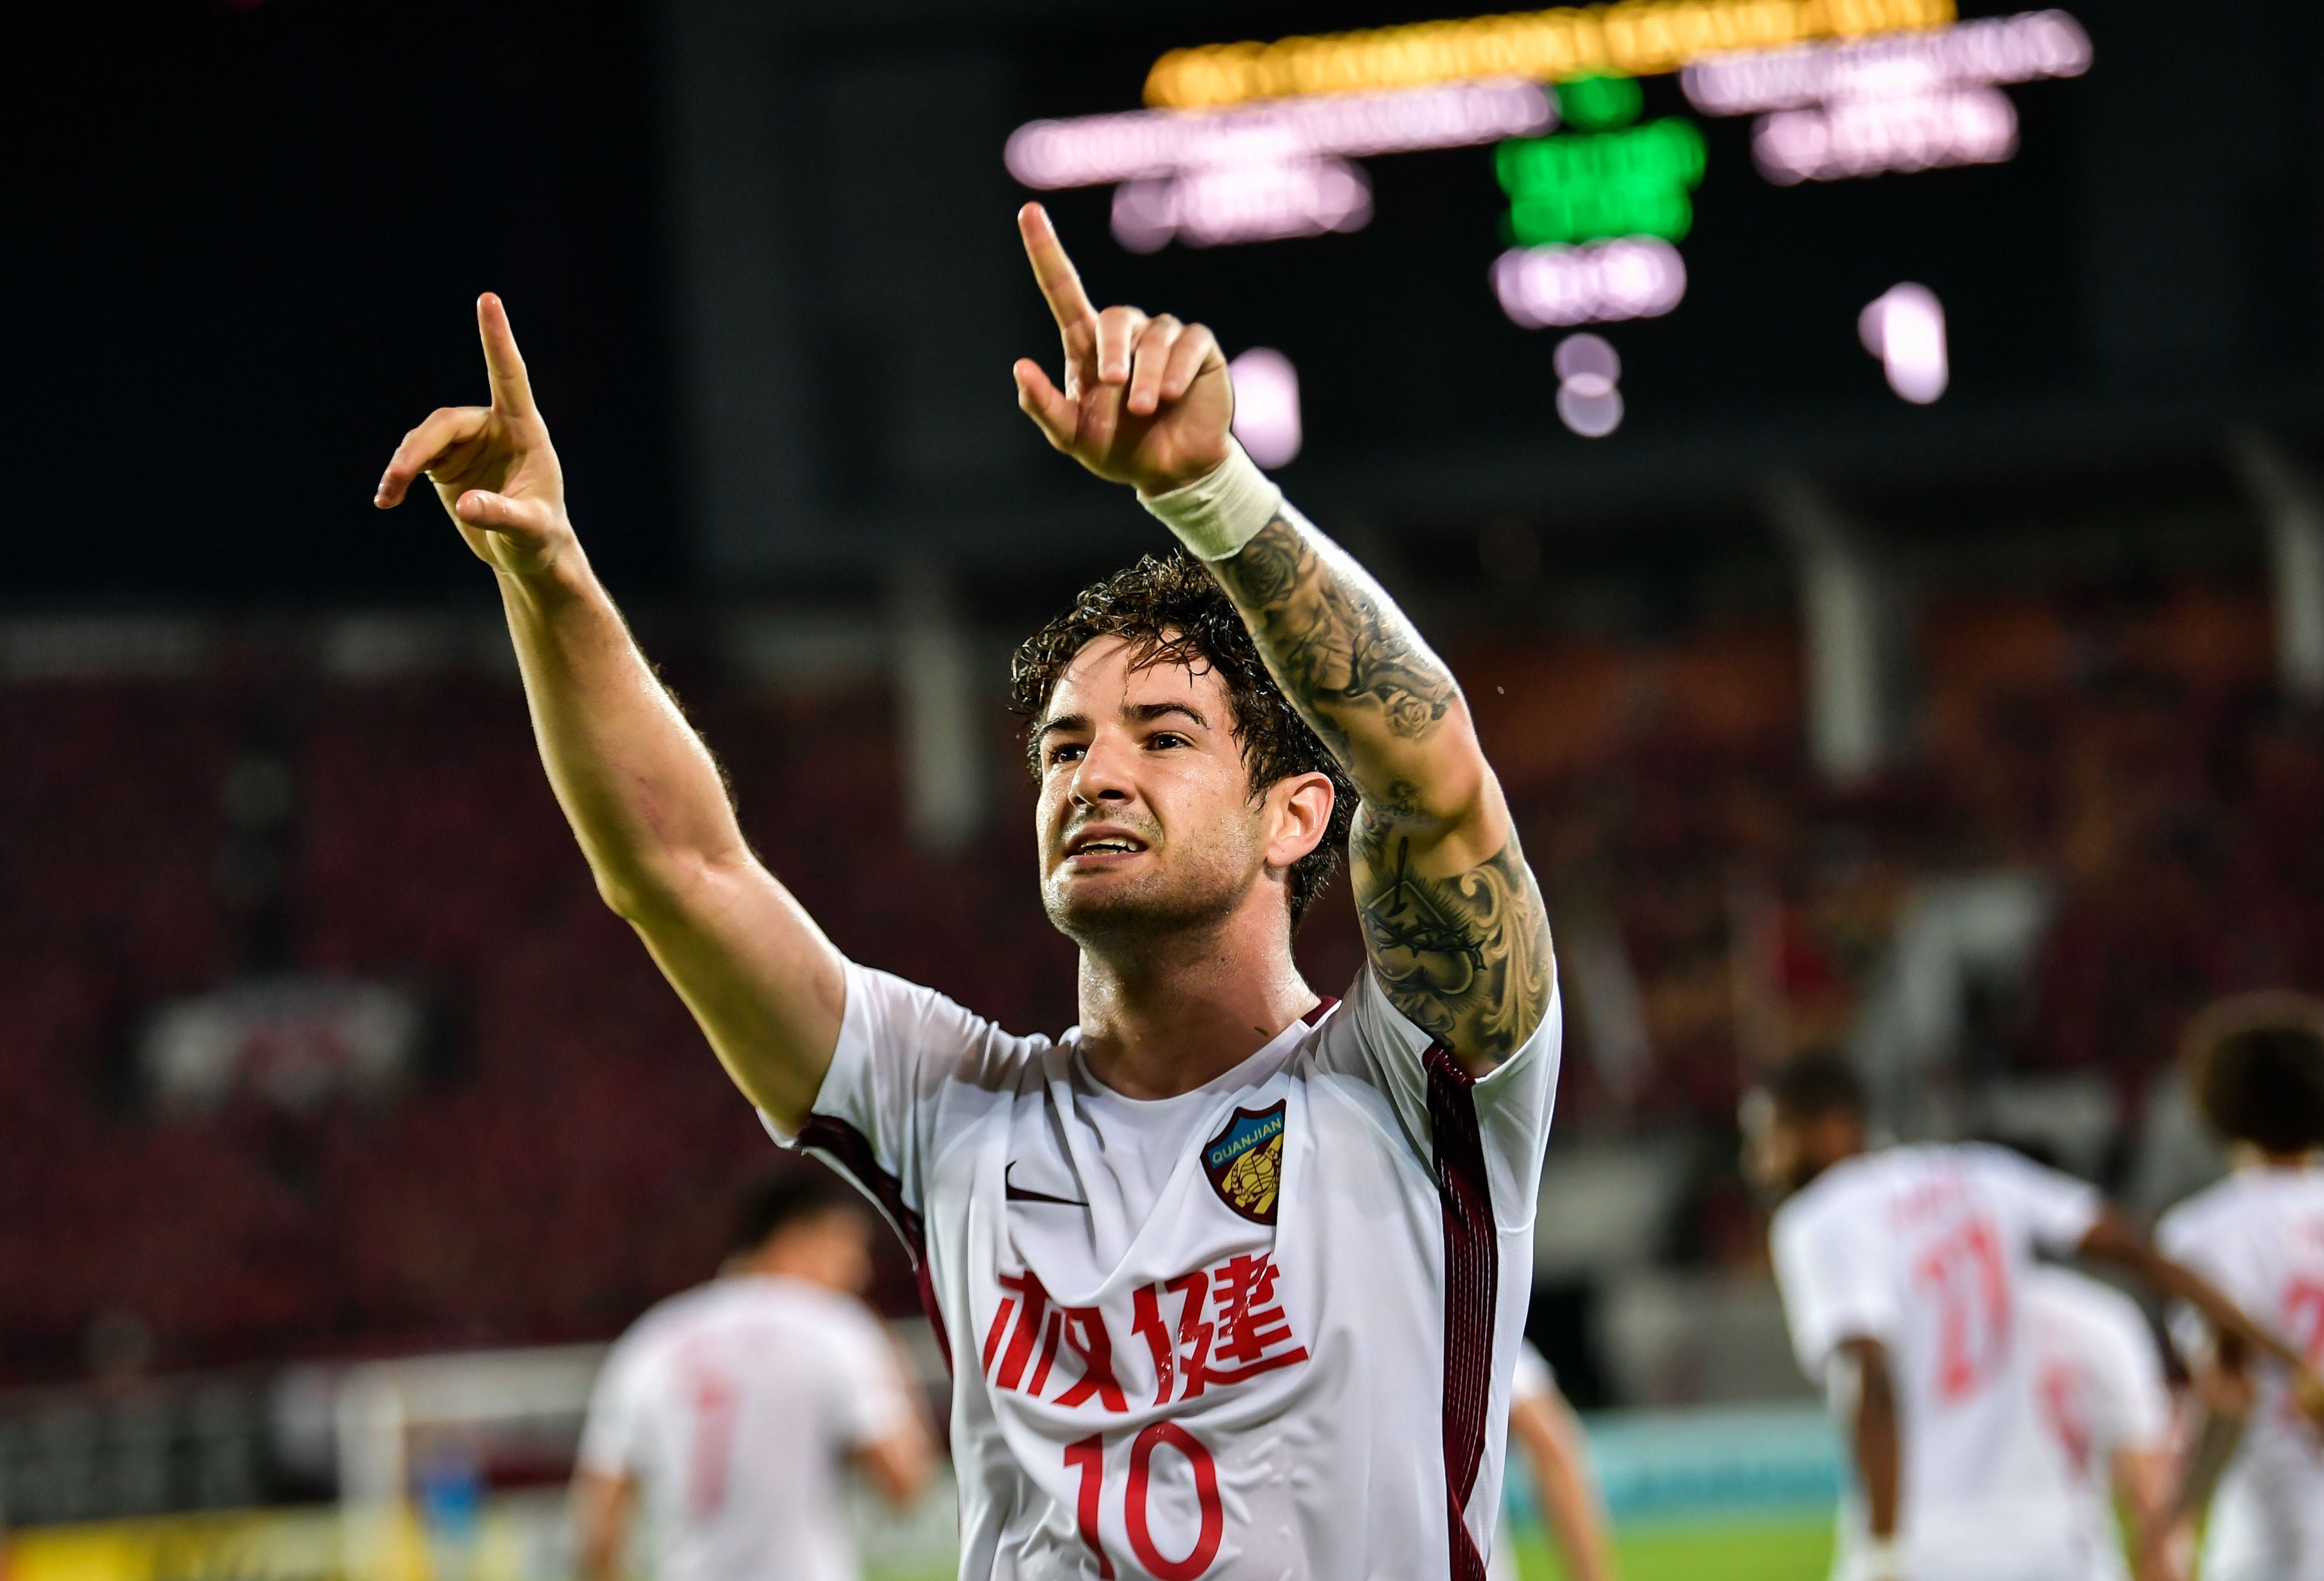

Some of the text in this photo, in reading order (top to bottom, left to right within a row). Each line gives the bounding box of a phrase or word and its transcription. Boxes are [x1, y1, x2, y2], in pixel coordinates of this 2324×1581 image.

[1212, 1117, 1282, 1164] QUANJIAN
[982, 1252, 1309, 1413] 权健
[1063, 1420, 1224, 1581] 10
